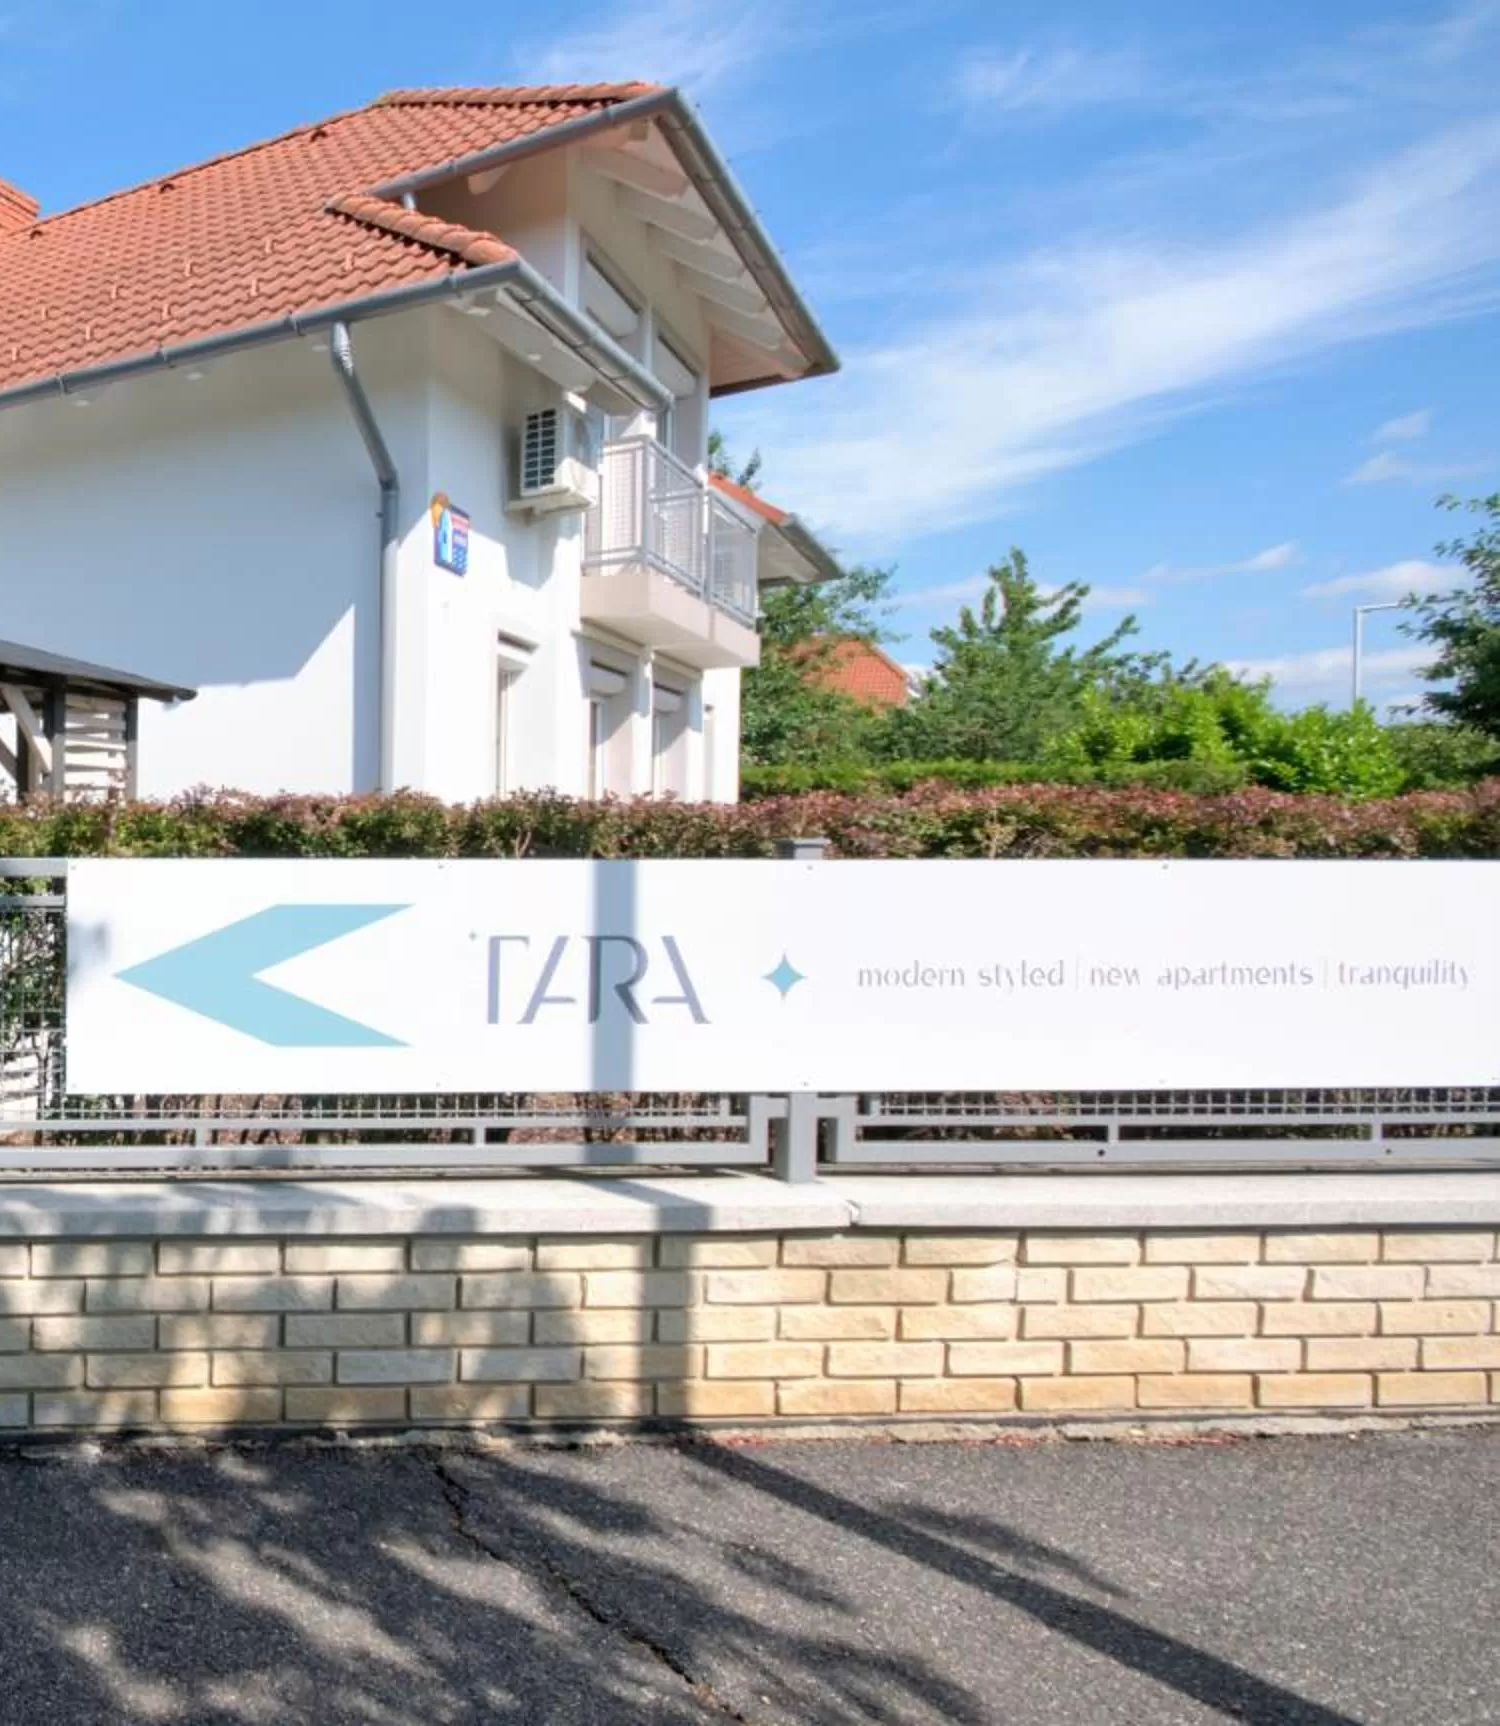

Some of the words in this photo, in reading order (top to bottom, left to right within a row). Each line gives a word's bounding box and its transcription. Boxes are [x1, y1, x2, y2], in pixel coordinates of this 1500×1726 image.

[485, 935, 712, 1025] TARA
[857, 959, 965, 987] modern
[977, 959, 1065, 993] styled
[1089, 966, 1141, 986] new
[1156, 961, 1314, 991] apartments
[1338, 959, 1469, 991] tranquility
